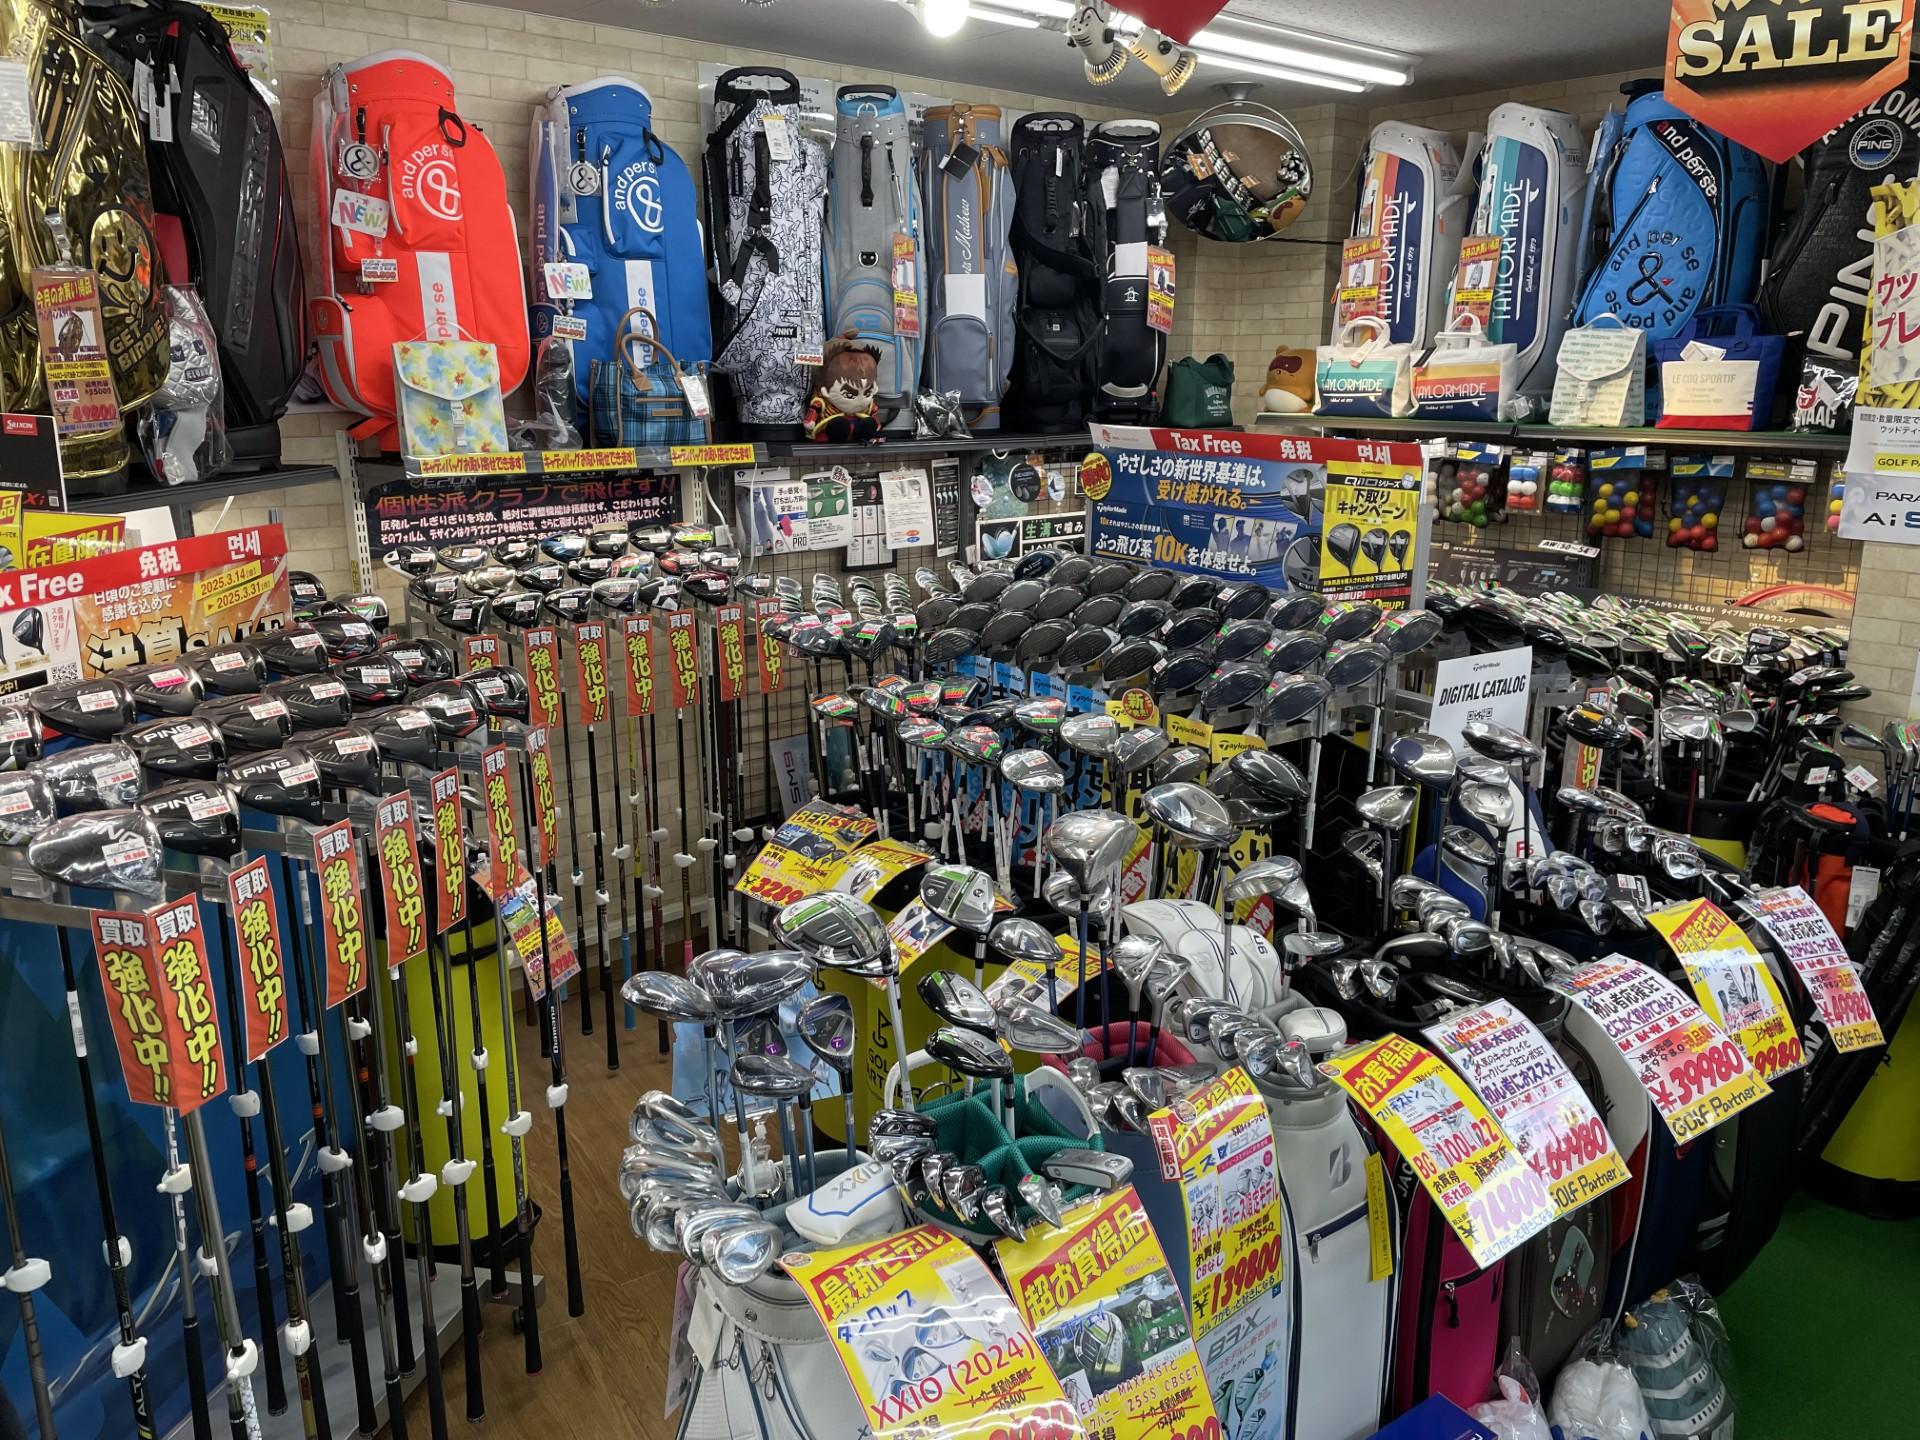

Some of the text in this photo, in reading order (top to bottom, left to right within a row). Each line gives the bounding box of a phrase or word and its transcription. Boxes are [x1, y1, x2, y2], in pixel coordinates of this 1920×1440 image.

[1675, 4, 1902, 78] SALE
[1656, 121, 1719, 198] and per se
[1858, 140, 1893, 150] PING
[401, 144, 440, 200] and per
[615, 161, 650, 211] and per
[1378, 190, 1403, 323] TAYLORMADE
[1492, 179, 1524, 319] TAYLORMADE
[1610, 233, 1641, 273] and
[1647, 230, 1683, 247] per
[1681, 246, 1701, 272] se
[433, 282, 451, 338] per se
[638, 287, 647, 306] se
[110, 322, 142, 355] GET
[1171, 432, 1242, 454] Tax Free
[1280, 439, 1312, 460] 免税
[1117, 453, 1267, 488] やさしさの新世界基準は、
[1878, 458, 1908, 467] GOLF
[1156, 480, 1248, 511] 受け継がれる。
[1337, 500, 1406, 520] キャンペーン
[1354, 488, 1390, 504] 下取り
[1863, 512, 1897, 527] Ai
[140, 547, 181, 577] 免税
[227, 530, 262, 561] 면세
[1095, 531, 1257, 577] ぶっ飛び系10Kを体感せよ。
[20, 572, 84, 602] Free
[94, 577, 177, 605] 日頃のご愛顧に
[102, 597, 172, 623] 感謝を込めて
[627, 619, 651, 632] 買取
[670, 613, 691, 628] 買取
[719, 608, 740, 622] 買取
[759, 602, 778, 616] 買取
[469, 639, 496, 654] 買取
[527, 631, 553, 646] 買取
[578, 625, 602, 641] 買取
[628, 635, 653, 713] 強化中!!
[671, 629, 697, 704] 強化中!!
[721, 623, 744, 697] 強化中!!
[527, 647, 559, 727] 強化中!!
[580, 641, 607, 721] 強化中!!
[1438, 674, 1528, 707] DIGITAL CATALOG
[143, 724, 192, 742] PING
[528, 728, 547, 750] 買取
[242, 759, 291, 778] PING
[486, 751, 507, 775] 買取
[152, 792, 208, 813] PING
[433, 771, 458, 803] 買取
[378, 797, 409, 830] 買取
[532, 753, 556, 860] 強化中!!
[319, 828, 350, 862] 買取
[487, 778, 518, 888] 強化中!!
[437, 802, 464, 921] 強化中!!
[234, 866, 269, 905] 買取
[382, 825, 424, 956] 強化中!!
[98, 918, 147, 948] 買取
[155, 903, 196, 945] 買取
[324, 857, 363, 993] 強化中!!
[240, 900, 284, 1045] 強化中!!
[103, 950, 171, 1105] 強化中!!
[163, 941, 219, 1098] 強化中!!
[1355, 1039, 1422, 1104] お買得品
[1710, 1083, 1757, 1117] Partner
[1154, 1122, 1177, 1180] 現品限り
[1577, 1167, 1618, 1196] Partner
[820, 1229, 947, 1320] 最新モデル
[1024, 1202, 1147, 1319] 超お買得品
[1211, 1234, 1282, 1315] 139800
[871, 1376, 943, 1430] XXIO
[947, 1330, 1036, 1394] (2024)
